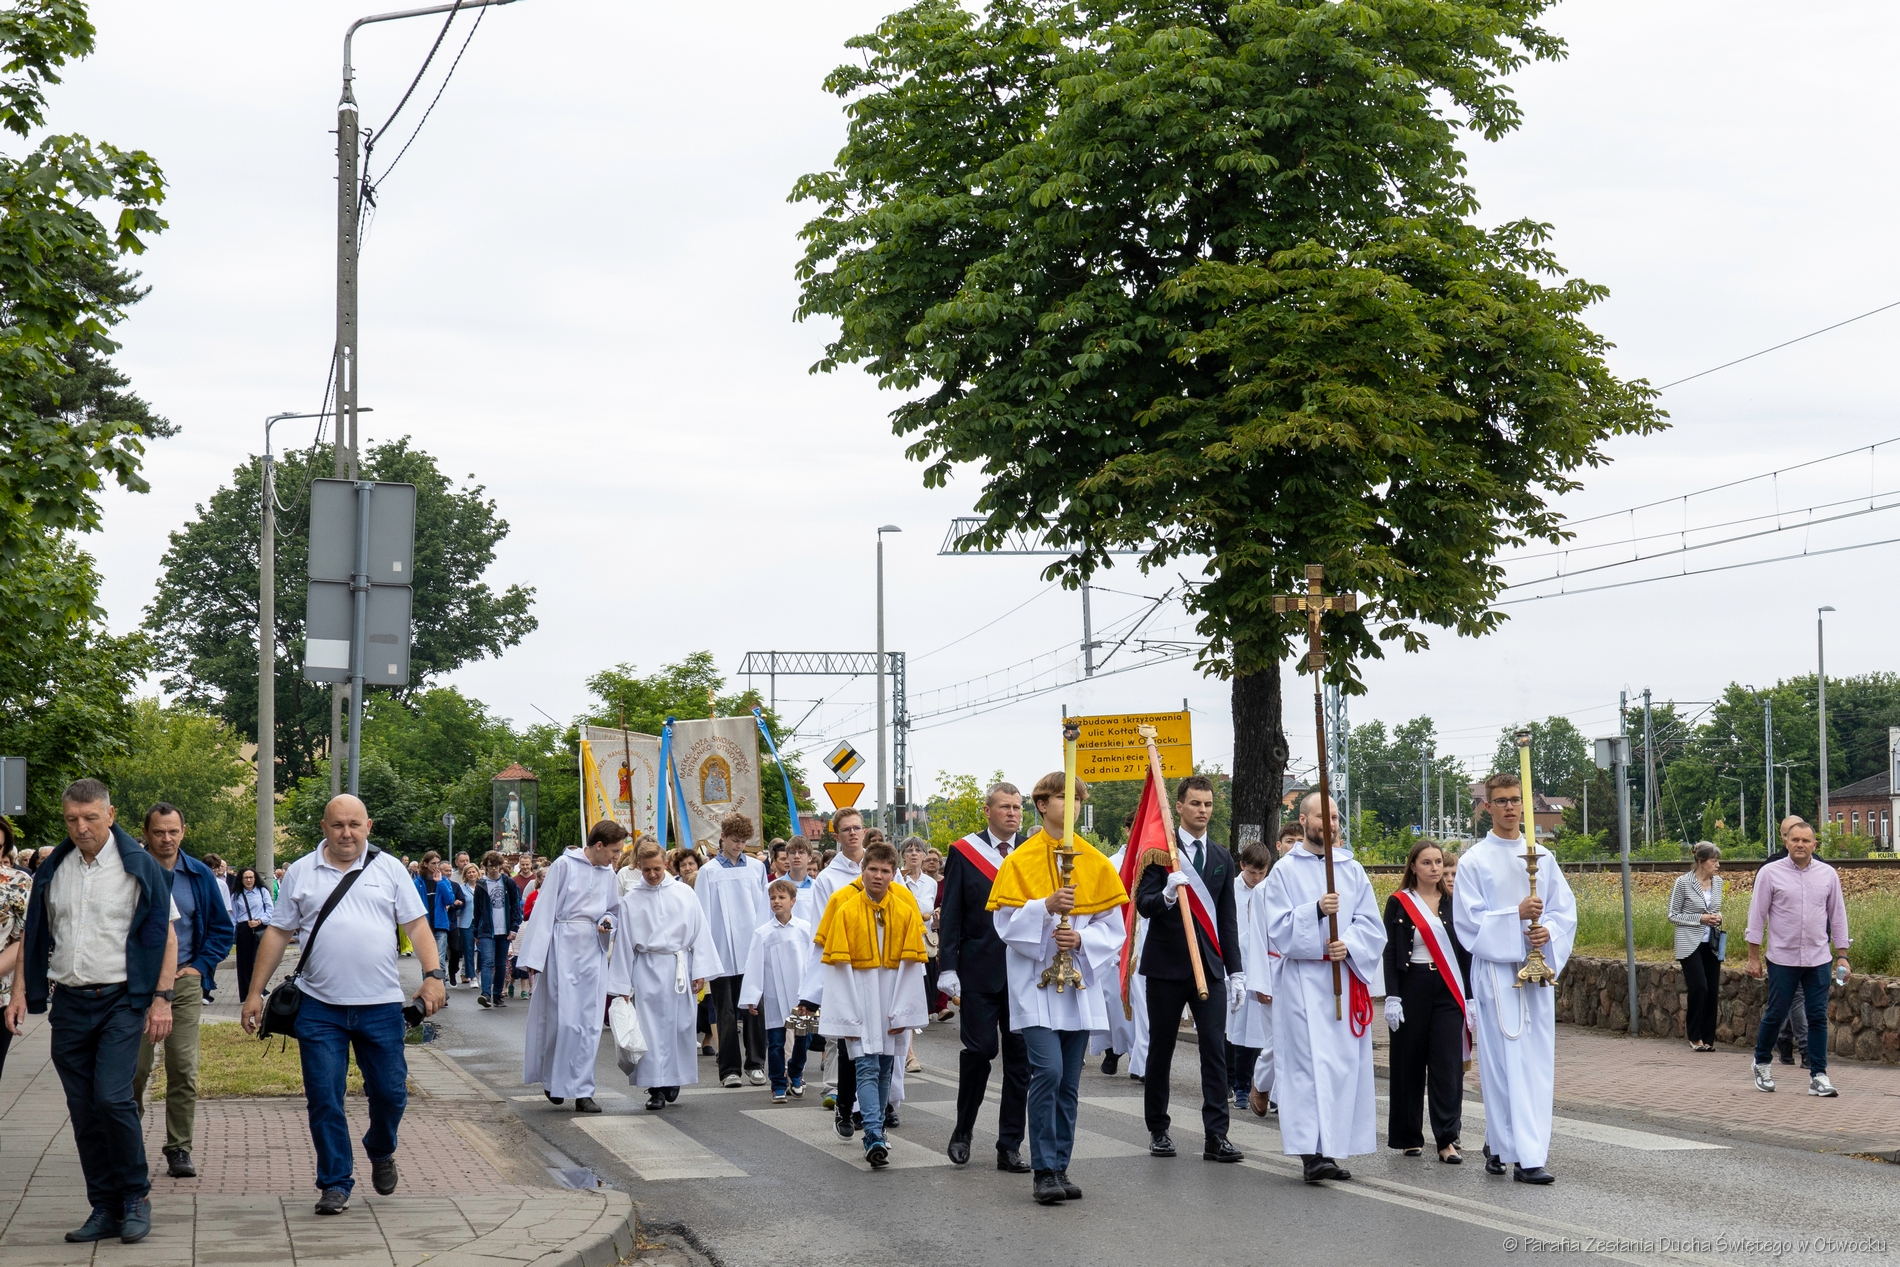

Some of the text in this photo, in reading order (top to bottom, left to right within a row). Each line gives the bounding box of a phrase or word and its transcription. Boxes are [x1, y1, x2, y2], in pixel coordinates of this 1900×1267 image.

[1122, 714, 1182, 724] skrzyżowania
[1088, 729, 1104, 737] ulic
[1108, 727, 1140, 737] Kołłąt
[1075, 739, 1124, 748] widerskiej
[1138, 736, 1178, 746] Oocku
[679, 753, 692, 780] MATKO
[690, 737, 709, 753] BOŻA
[686, 743, 742, 778] PATRONKO OTWOCKA
[1083, 767, 1096, 775] od
[1099, 766, 1120, 774] dnia
[1124, 764, 1134, 773] 27
[1144, 764, 1167, 772] 25
